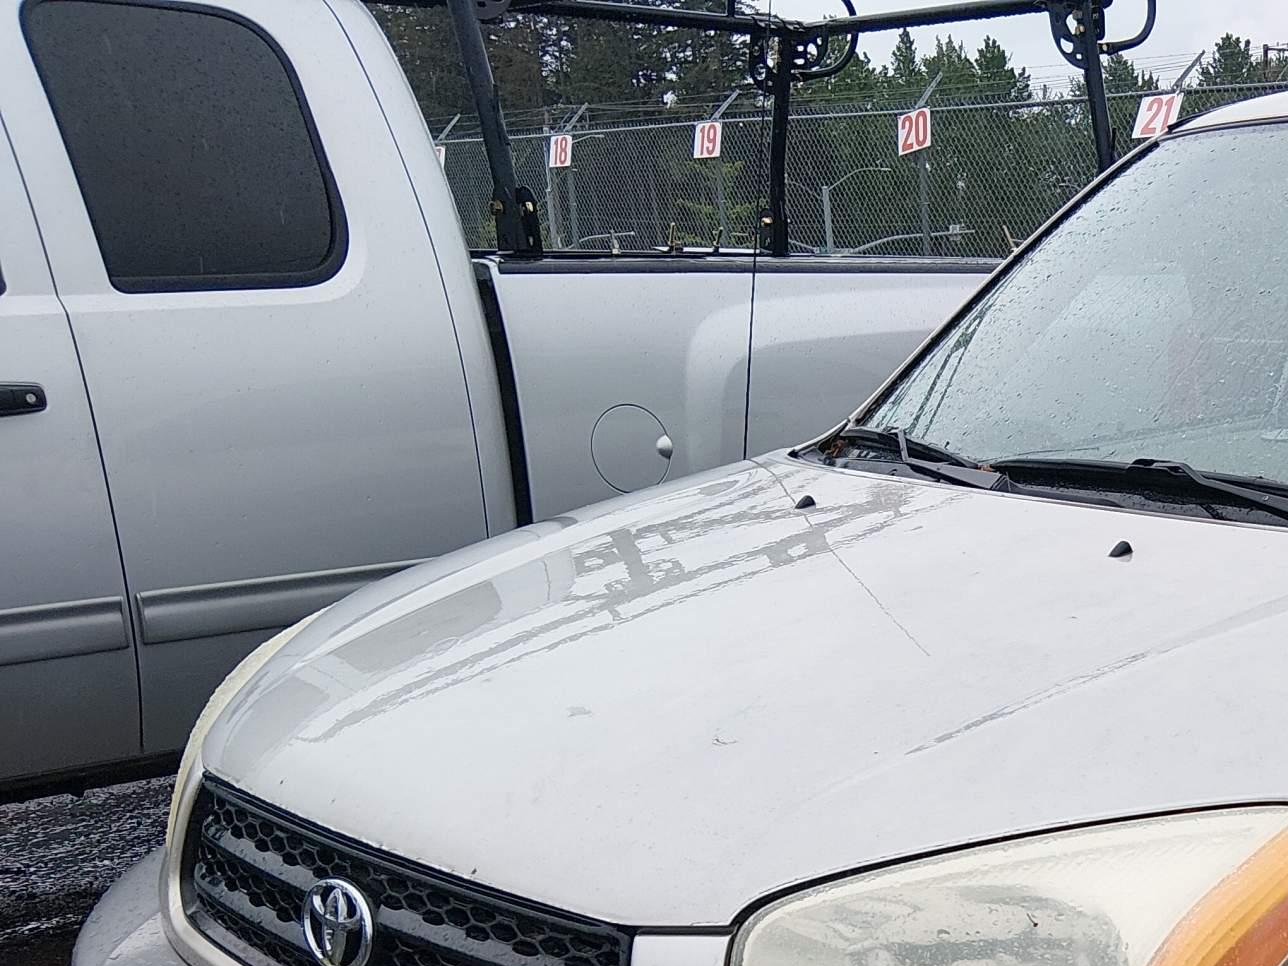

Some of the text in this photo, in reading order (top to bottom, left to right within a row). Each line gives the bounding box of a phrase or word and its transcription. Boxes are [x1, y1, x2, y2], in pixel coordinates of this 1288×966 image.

[901, 110, 928, 152] 20
[1139, 96, 1176, 135] 21
[554, 136, 568, 165] 18
[700, 123, 717, 156] 19
